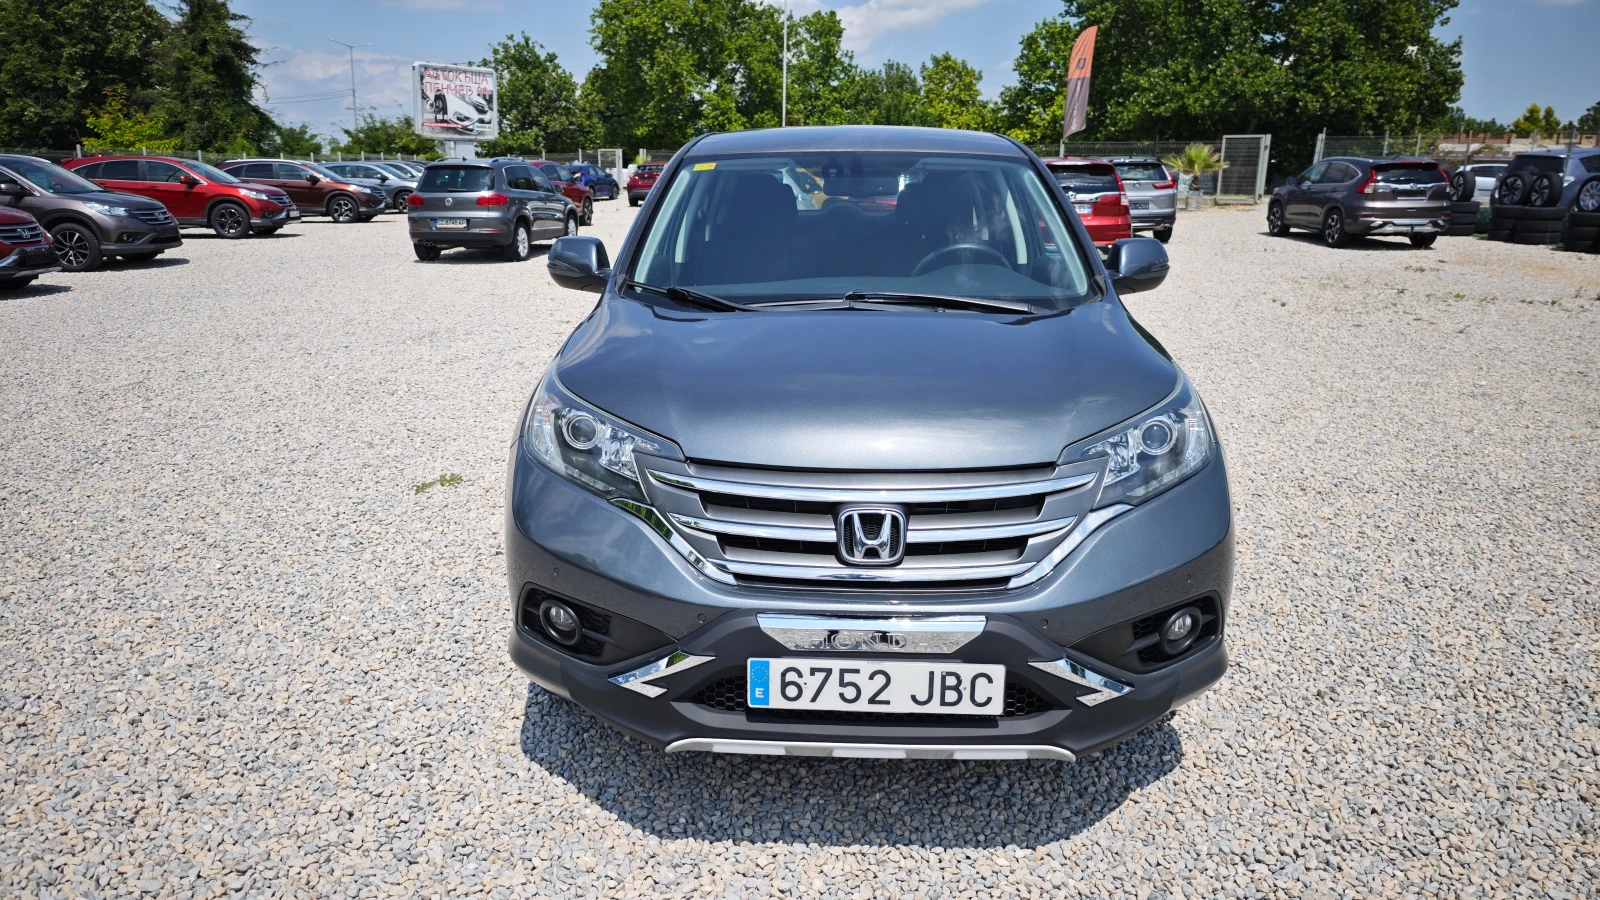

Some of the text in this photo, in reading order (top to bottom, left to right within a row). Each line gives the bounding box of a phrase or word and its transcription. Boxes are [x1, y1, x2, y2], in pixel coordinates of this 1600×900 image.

[424, 82, 473, 97] ПЕНЧЕВ
[754, 687, 765, 699] E
[779, 666, 994, 708] 6752 JBC
